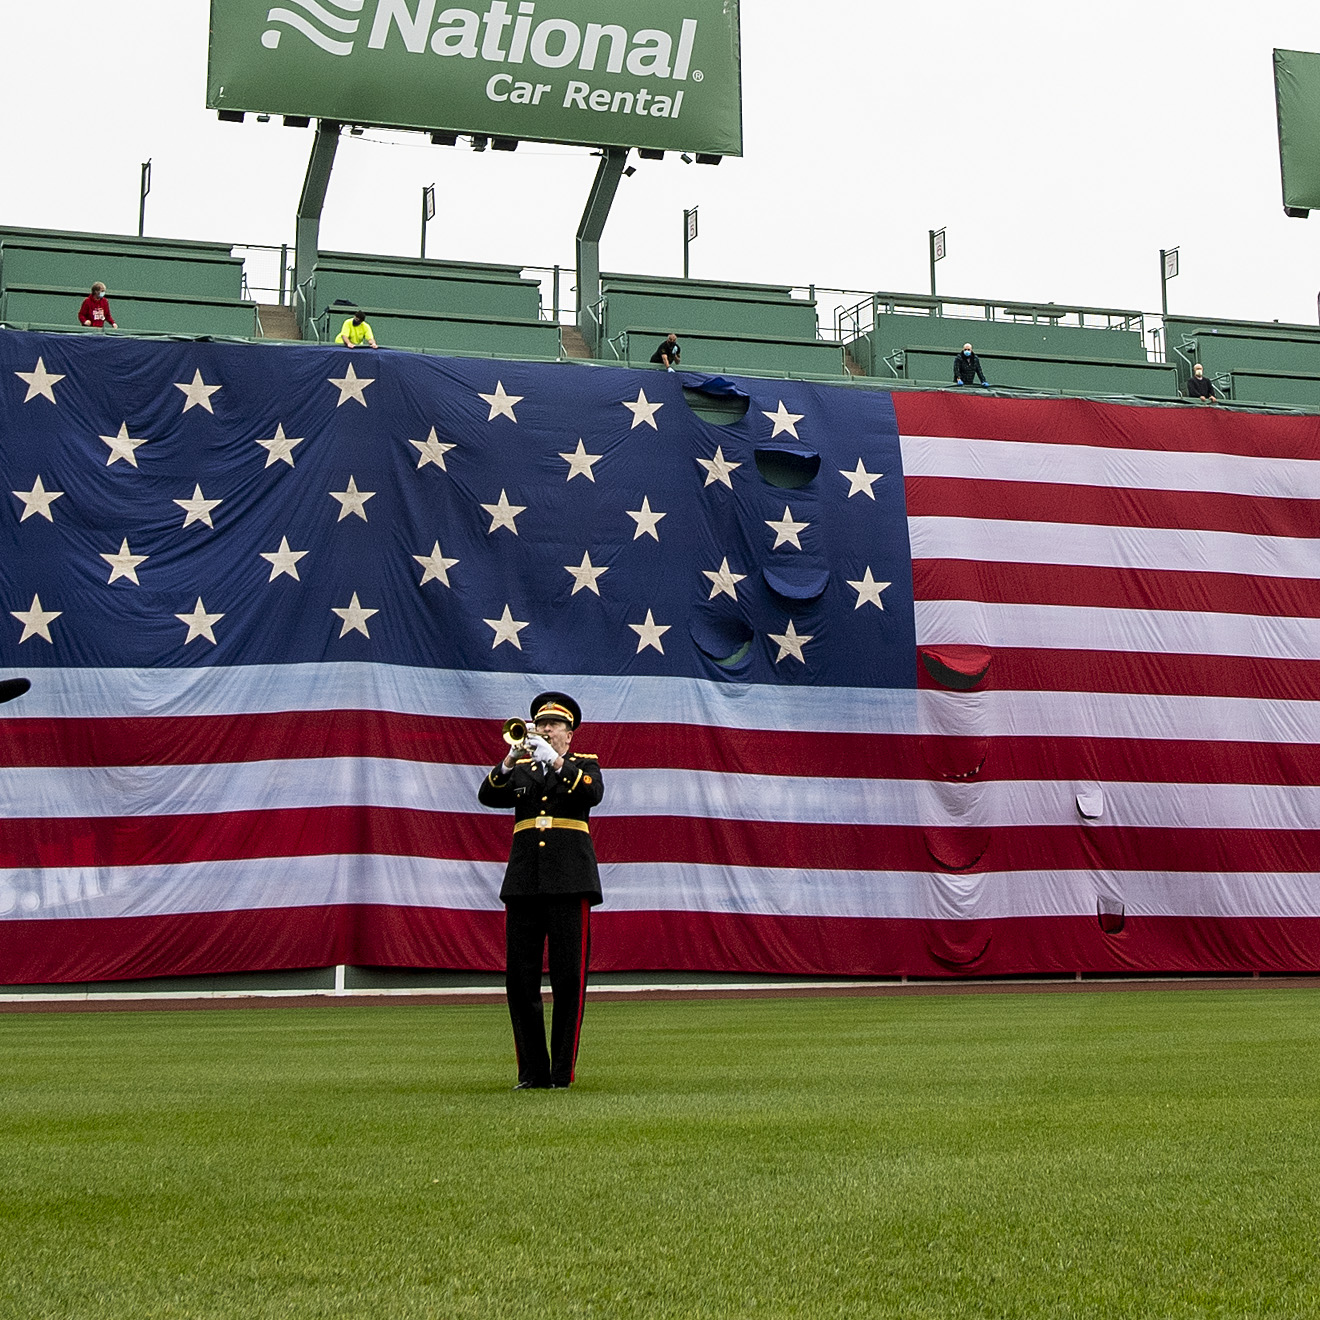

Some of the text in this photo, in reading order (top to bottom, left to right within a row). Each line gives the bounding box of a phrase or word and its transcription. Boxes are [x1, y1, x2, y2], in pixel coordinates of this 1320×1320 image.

[484, 73, 685, 119] Car Rental
[937, 244, 943, 257] 6
